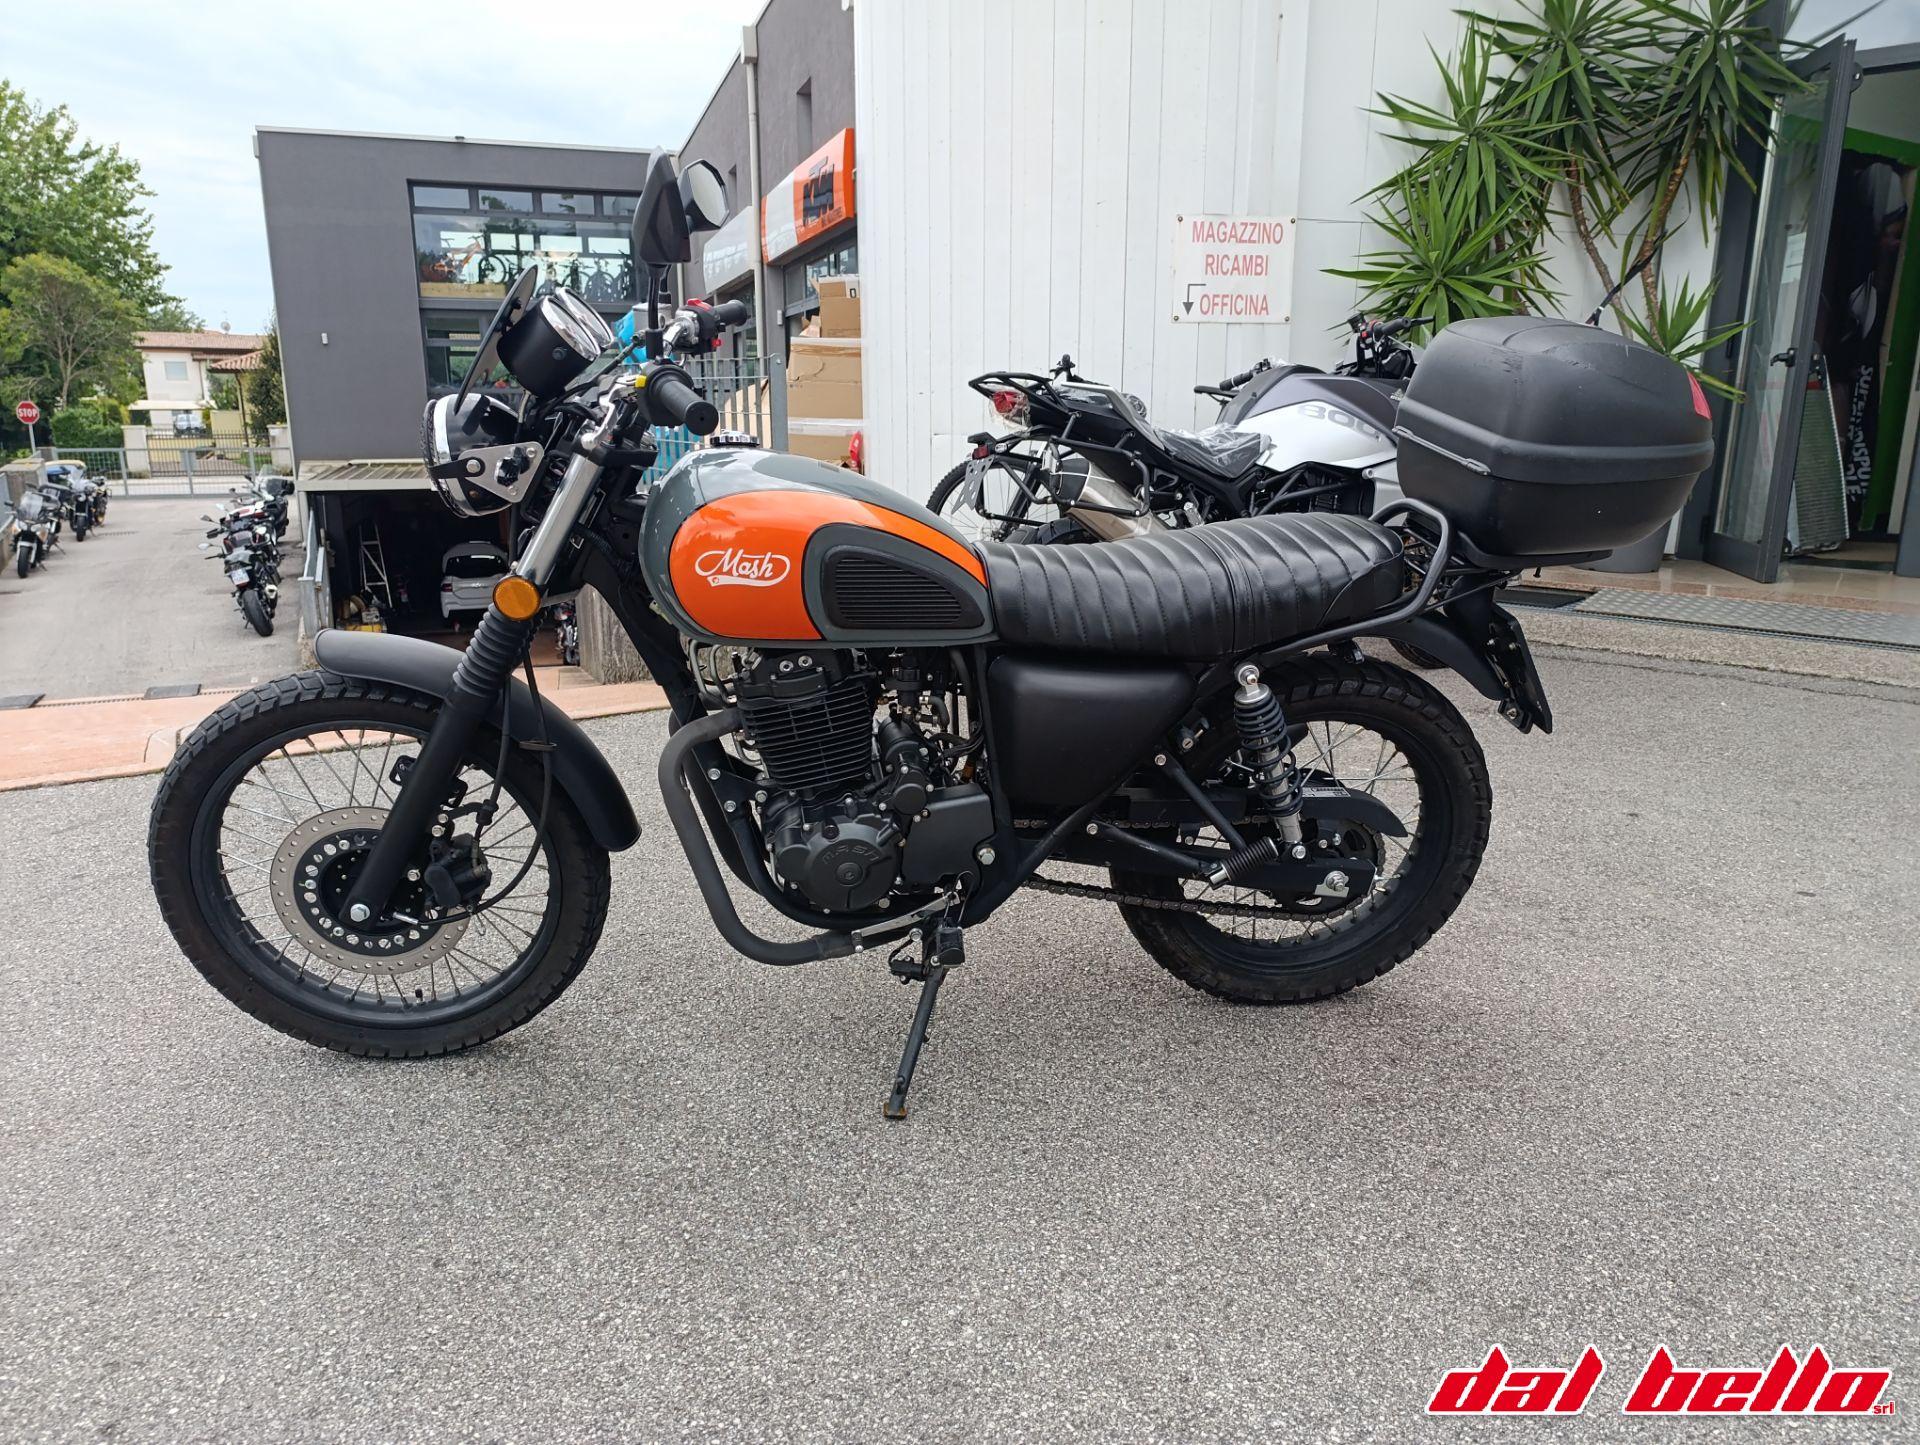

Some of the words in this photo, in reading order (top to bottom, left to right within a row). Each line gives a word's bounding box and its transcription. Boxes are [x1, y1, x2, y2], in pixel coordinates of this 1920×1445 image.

[803, 156, 835, 226] KTM
[1192, 221, 1284, 245] MAGAZZINO
[1204, 253, 1269, 276] RICAMBI
[1199, 294, 1270, 316] OFFICINA
[18, 408, 38, 418] STOP
[695, 547, 776, 580] Mash
